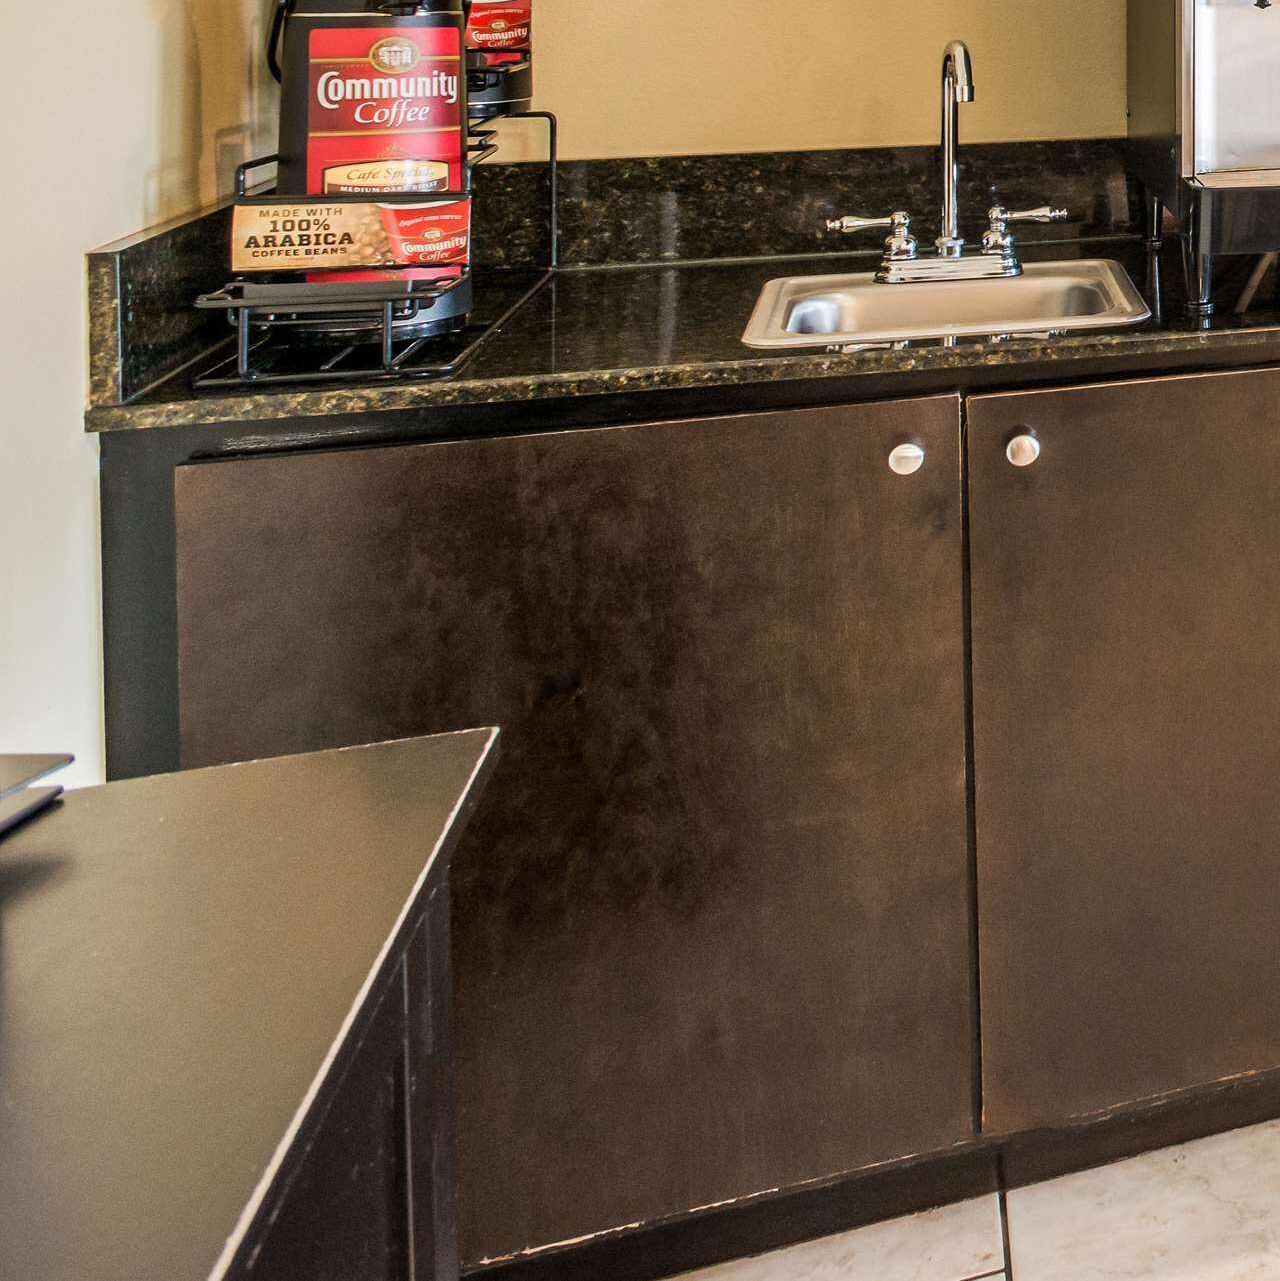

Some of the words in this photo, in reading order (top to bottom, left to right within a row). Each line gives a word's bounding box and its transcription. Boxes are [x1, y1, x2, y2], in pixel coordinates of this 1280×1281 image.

[471, 27, 528, 43] Community
[317, 70, 458, 110] Community
[354, 99, 430, 127] Coffee
[258, 208, 301, 218] MADE
[306, 207, 343, 217] WITH
[269, 218, 331, 233] 100%
[244, 231, 355, 249] ARABICA
[400, 234, 468, 254] Community
[251, 248, 301, 258] COFFEE
[304, 246, 348, 256] BEANS
